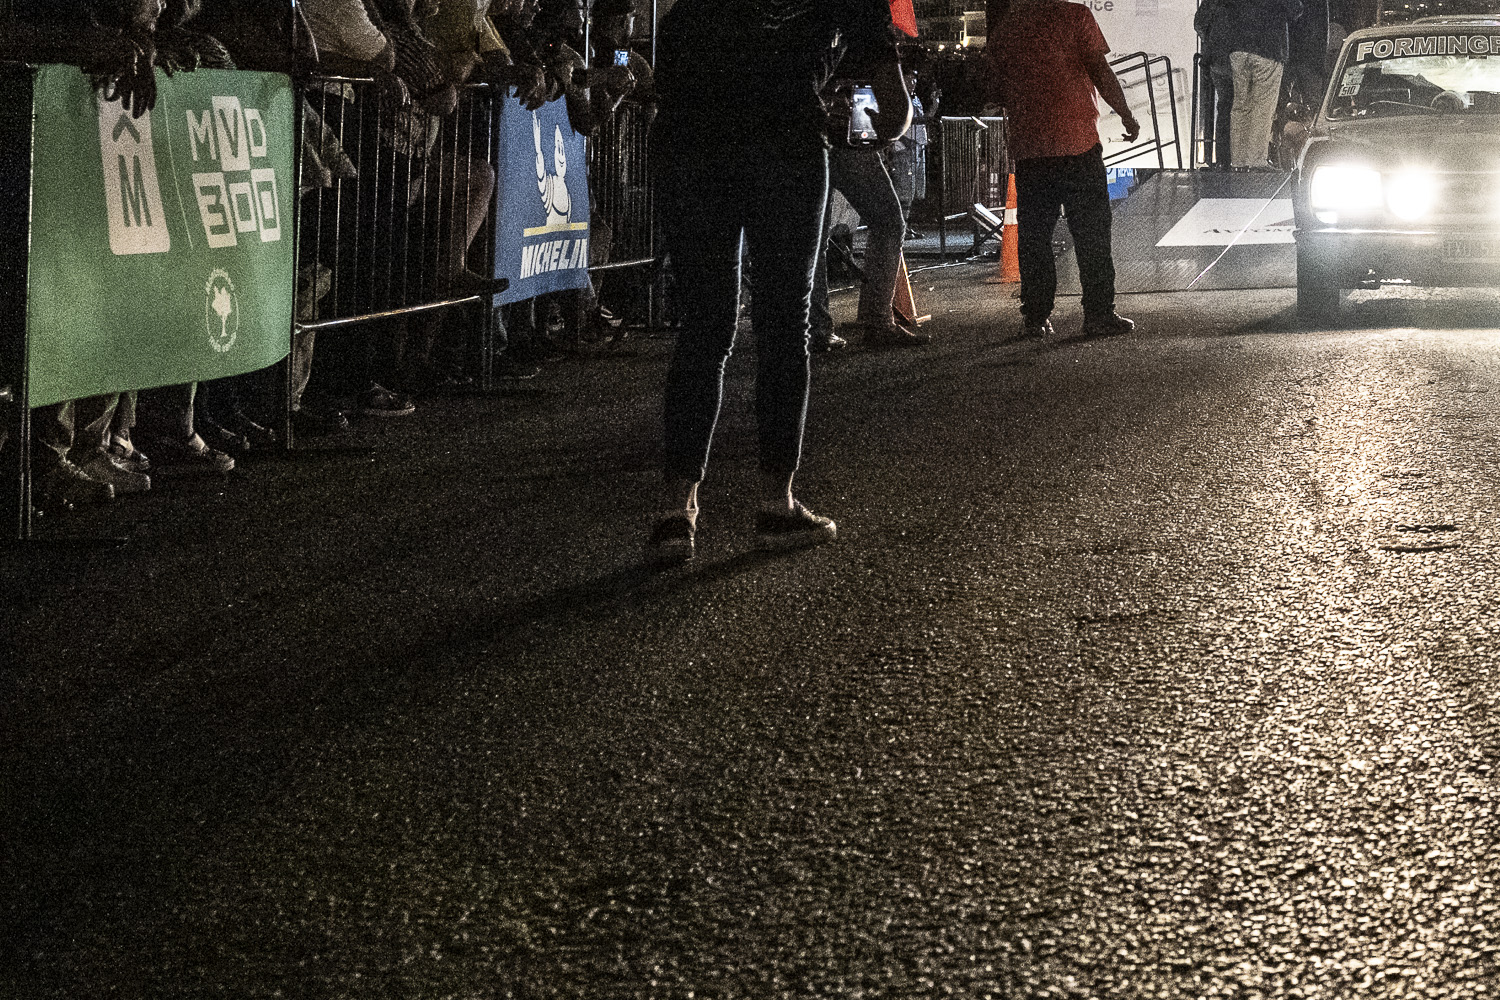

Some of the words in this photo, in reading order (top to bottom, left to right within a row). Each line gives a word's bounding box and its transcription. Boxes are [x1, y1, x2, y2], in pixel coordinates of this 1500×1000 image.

[186, 95, 267, 173] MVD
[192, 168, 281, 249] 300
[519, 238, 588, 280] MICHELIN
